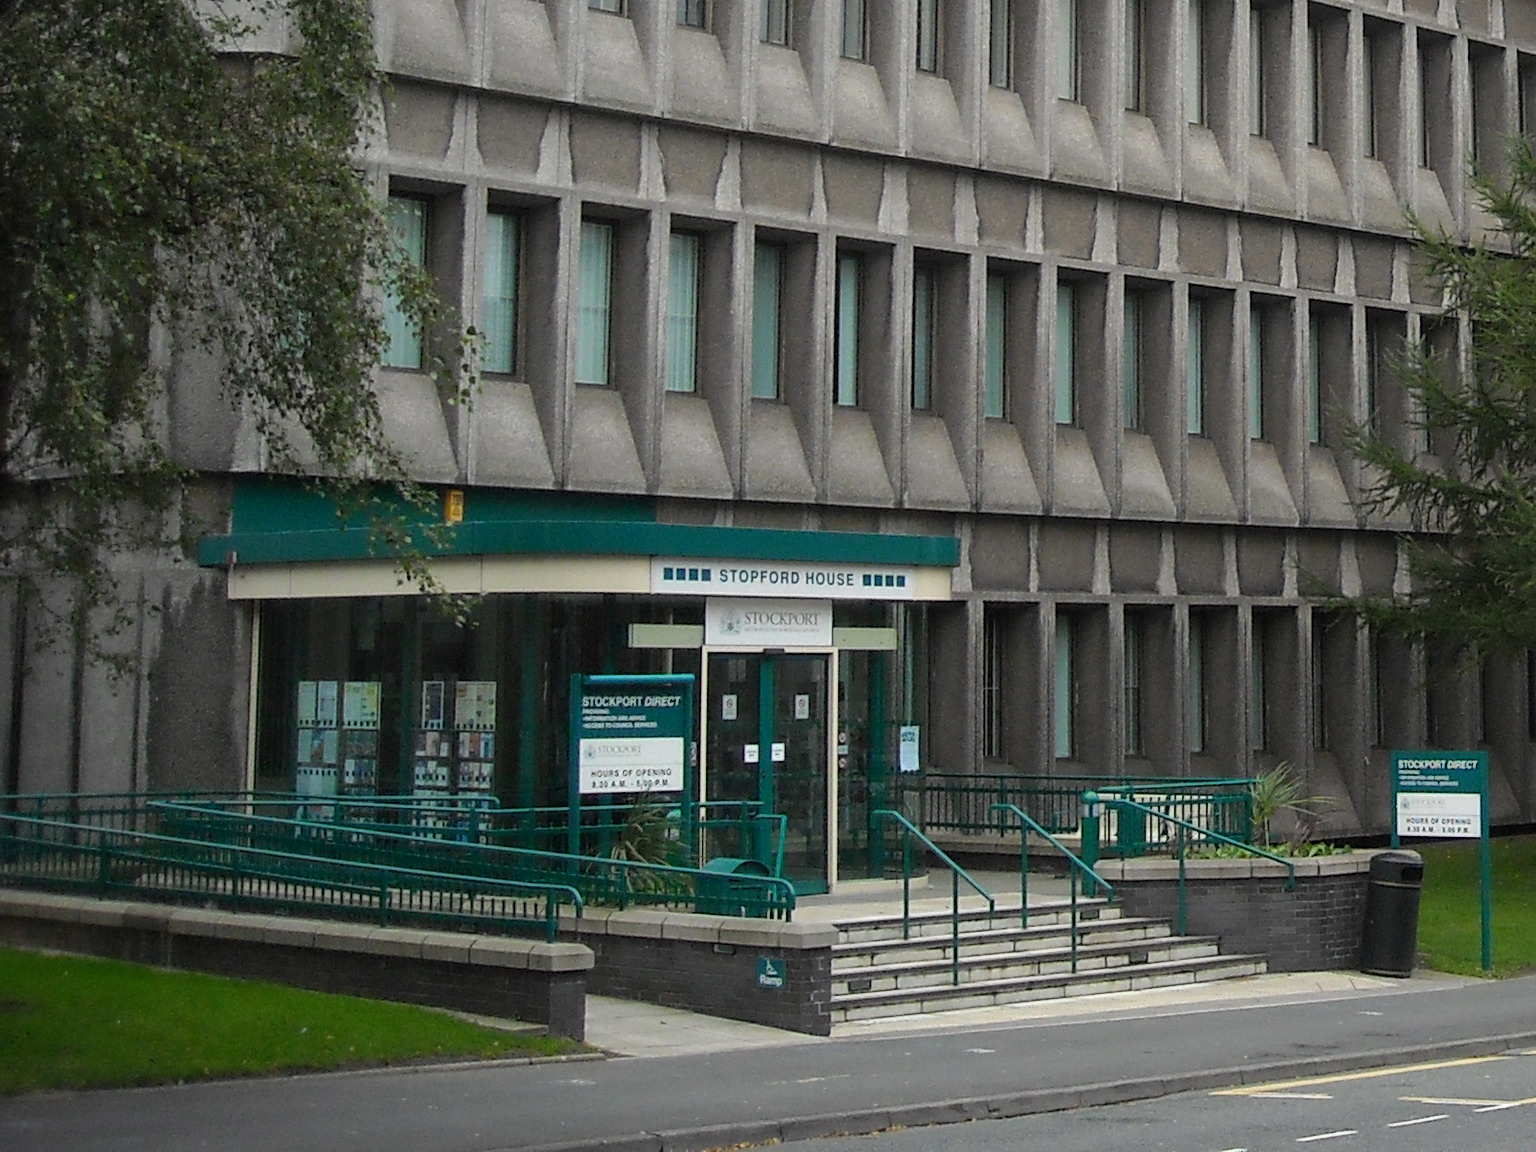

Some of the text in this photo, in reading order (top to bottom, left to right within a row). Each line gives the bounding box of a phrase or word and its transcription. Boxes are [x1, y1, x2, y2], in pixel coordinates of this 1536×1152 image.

[719, 569, 854, 587] STOPFORD HOUSE
[744, 611, 820, 626] STOCKPORT
[582, 695, 681, 707] STOCKPORT DIRECT
[598, 746, 641, 754] STOCKPORT
[1397, 759, 1479, 770] STOCKPORT DIRECT
[590, 768, 672, 778] HOURS OF OPENING
[1406, 817, 1428, 825] HOURS
[1430, 817, 1439, 825] OF
[760, 974, 783, 987] Ramp
